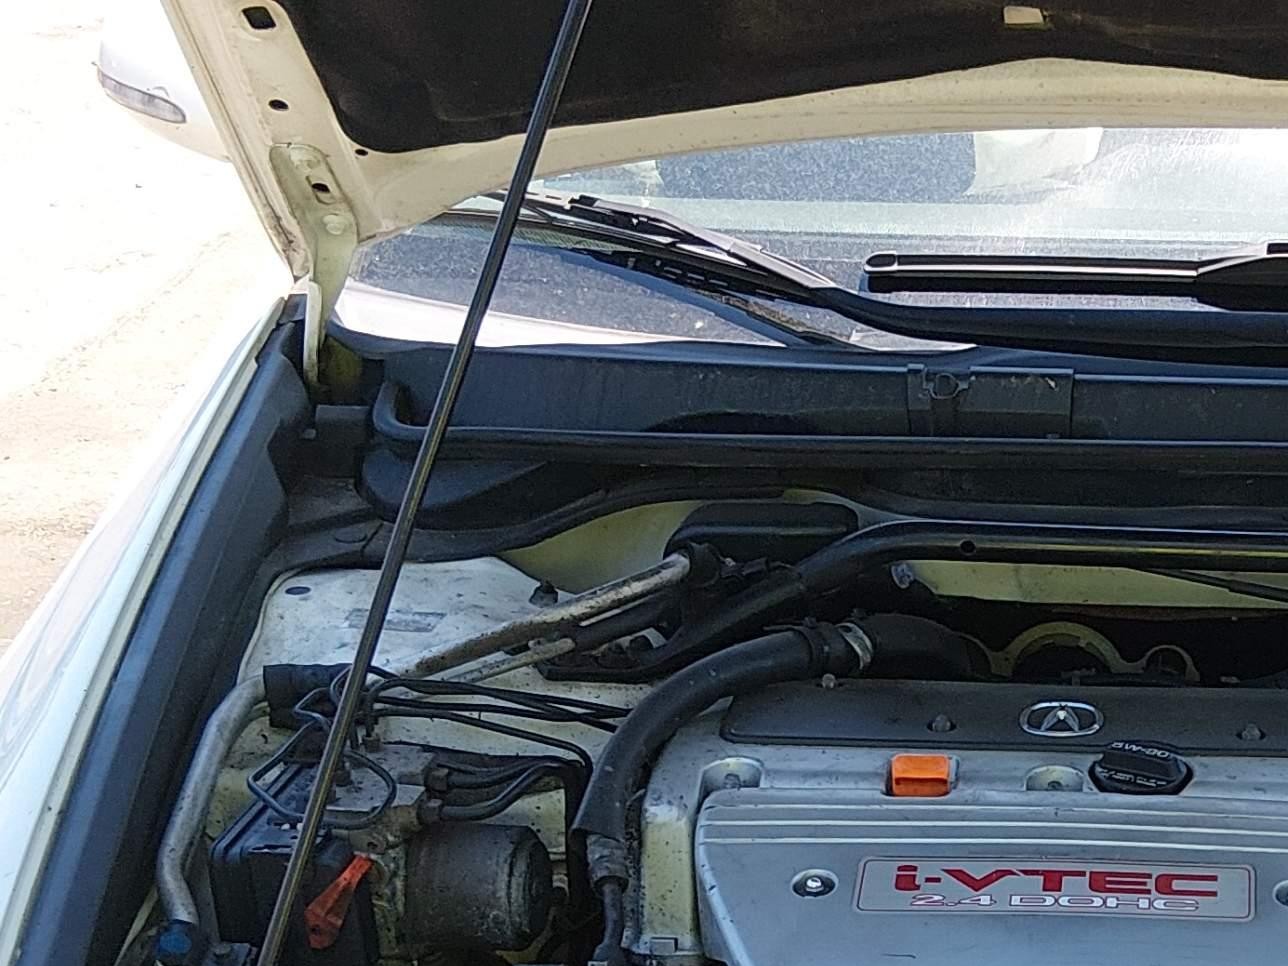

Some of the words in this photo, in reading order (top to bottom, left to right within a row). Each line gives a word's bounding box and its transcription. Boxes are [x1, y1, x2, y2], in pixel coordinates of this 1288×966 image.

[895, 865, 1218, 897] i-VTEC
[911, 894, 997, 907] 2.4
[1009, 895, 1199, 911] DOHC
